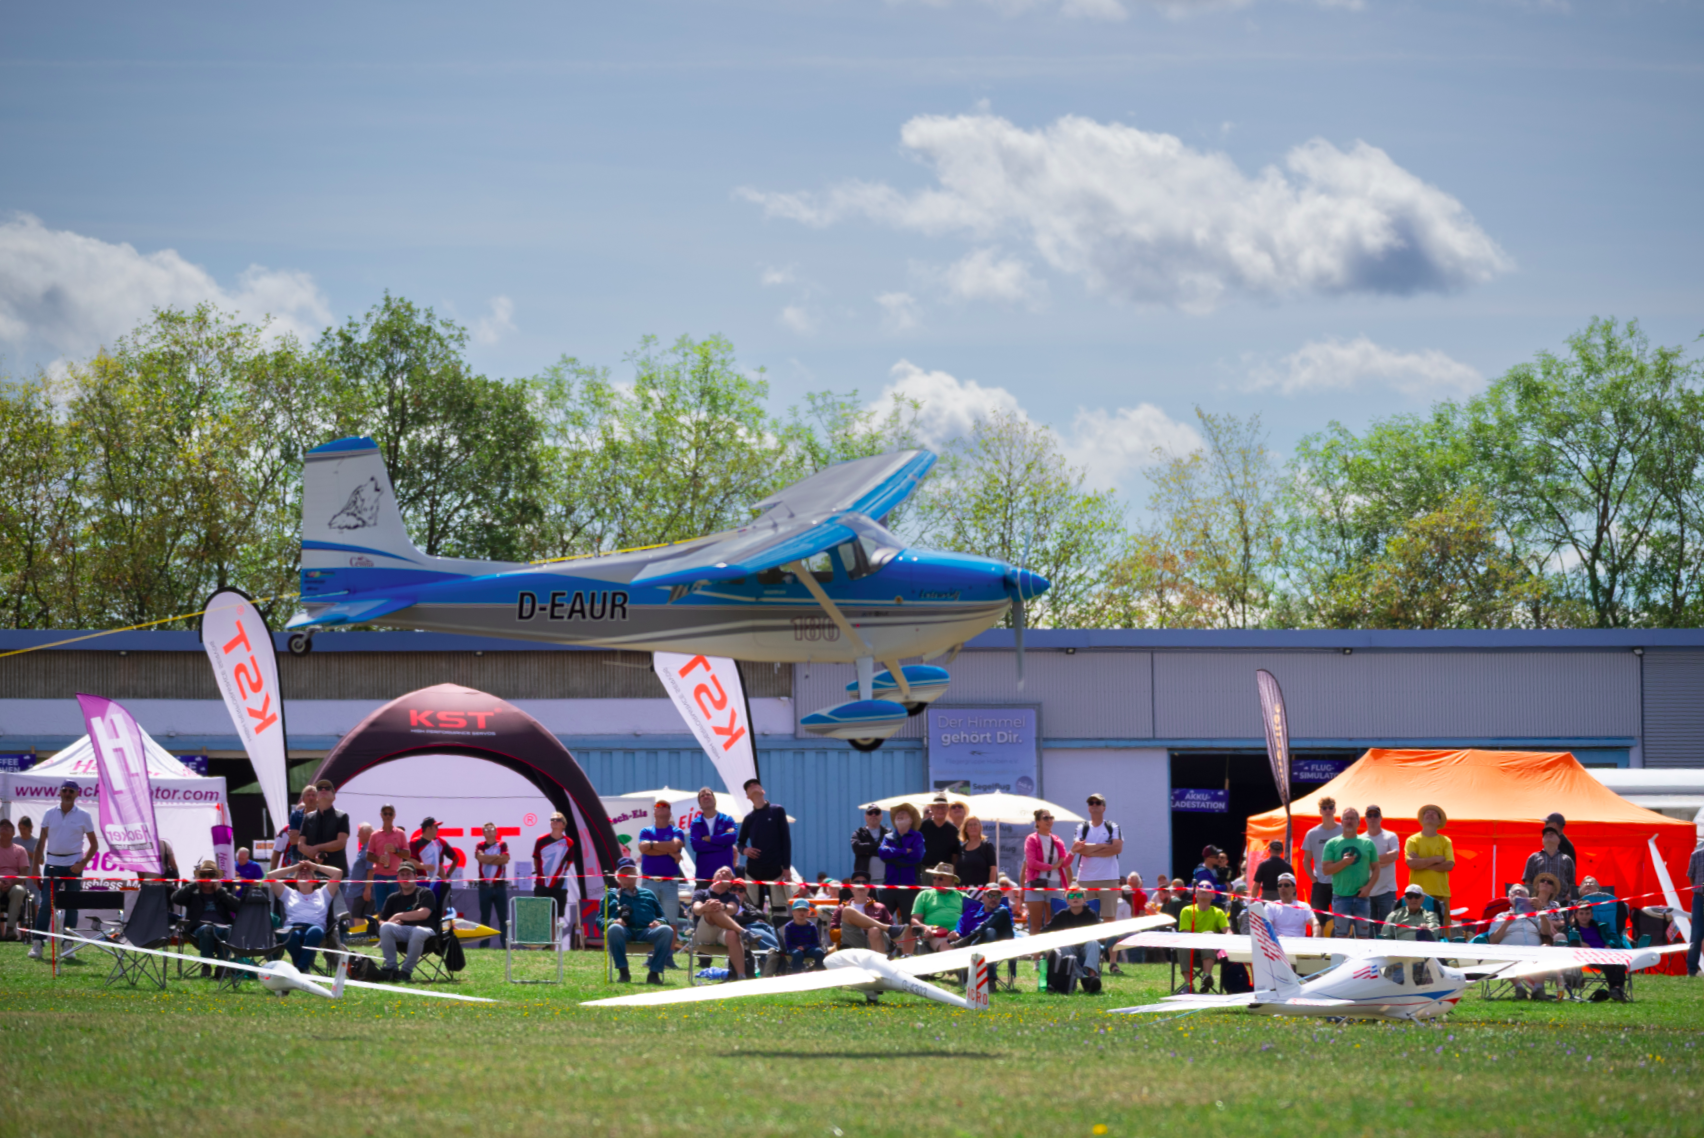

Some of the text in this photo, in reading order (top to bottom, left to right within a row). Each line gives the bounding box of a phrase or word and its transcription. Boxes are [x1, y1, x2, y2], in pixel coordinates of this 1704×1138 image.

[517, 590, 630, 621] D-EAUR
[790, 616, 840, 642] 180
[409, 709, 494, 729] KST
[938, 715, 1026, 728] Der Himmel
[941, 731, 1022, 747] gehört Dir.
[973, 783, 1011, 791] Segelflug
[1185, 793, 1211, 801] AKKU-
[967, 987, 988, 1005] ACRO
